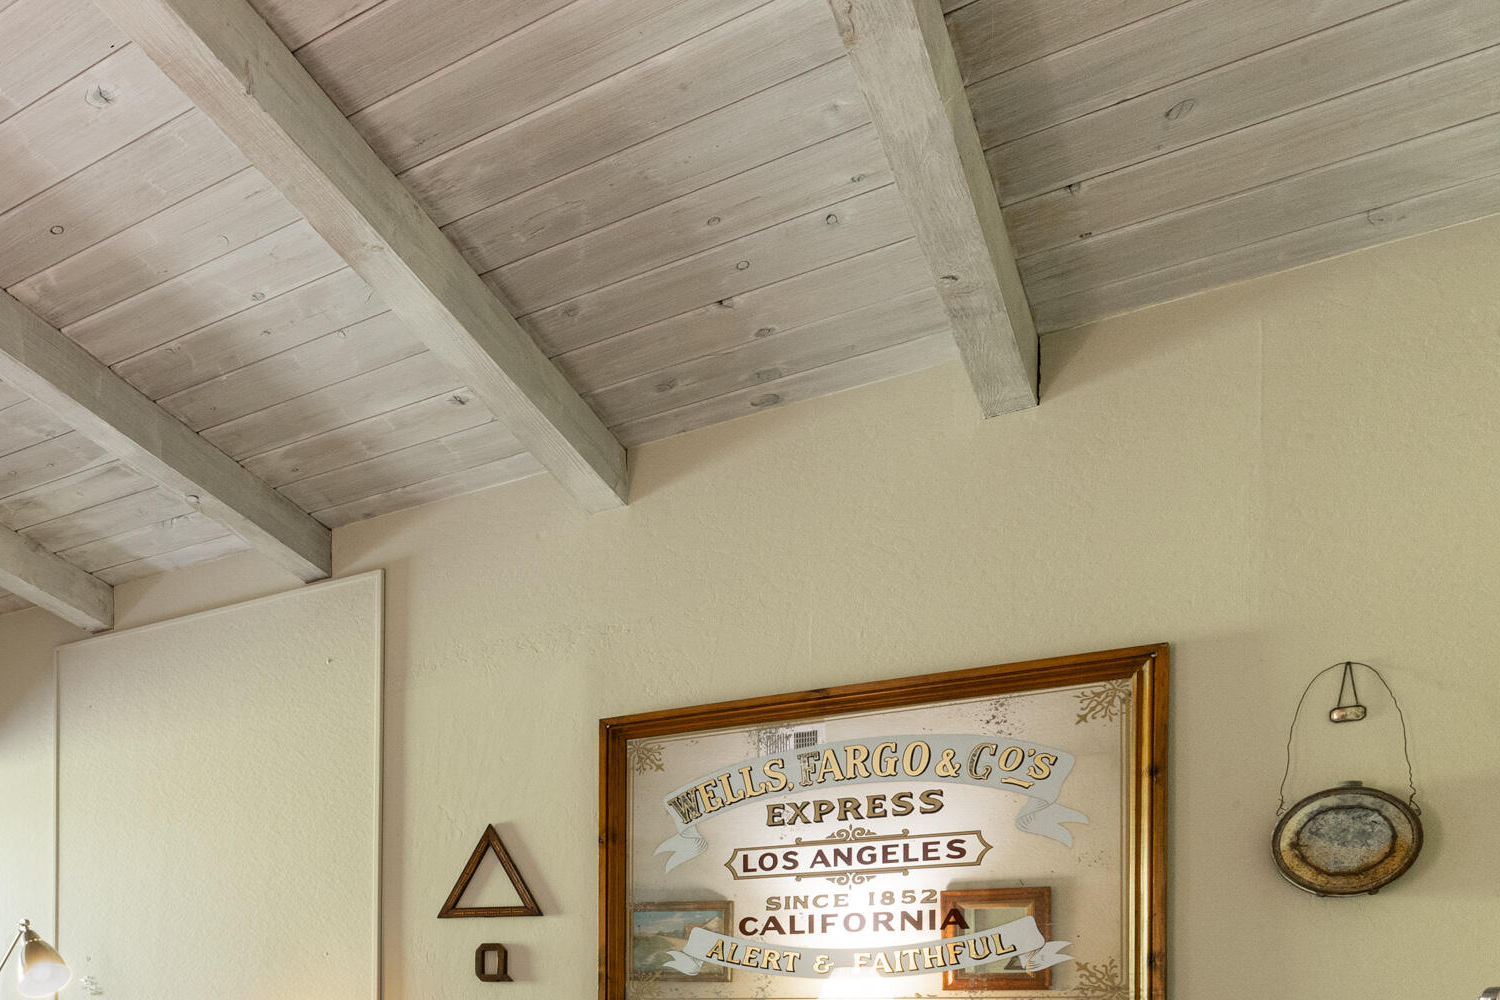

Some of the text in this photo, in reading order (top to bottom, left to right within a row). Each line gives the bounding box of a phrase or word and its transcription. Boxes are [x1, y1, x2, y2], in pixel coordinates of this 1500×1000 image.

[667, 758, 794, 824] WELLS,
[797, 740, 931, 786] FARGO
[934, 749, 961, 777] &
[765, 788, 945, 827] EXPRESS
[742, 838, 967, 873] LOS ANGELES
[765, 889, 938, 911] SINCE 1852
[738, 908, 970, 937] CALIFORNIA
[706, 932, 1016, 974] ALERT & FAITHFUL
